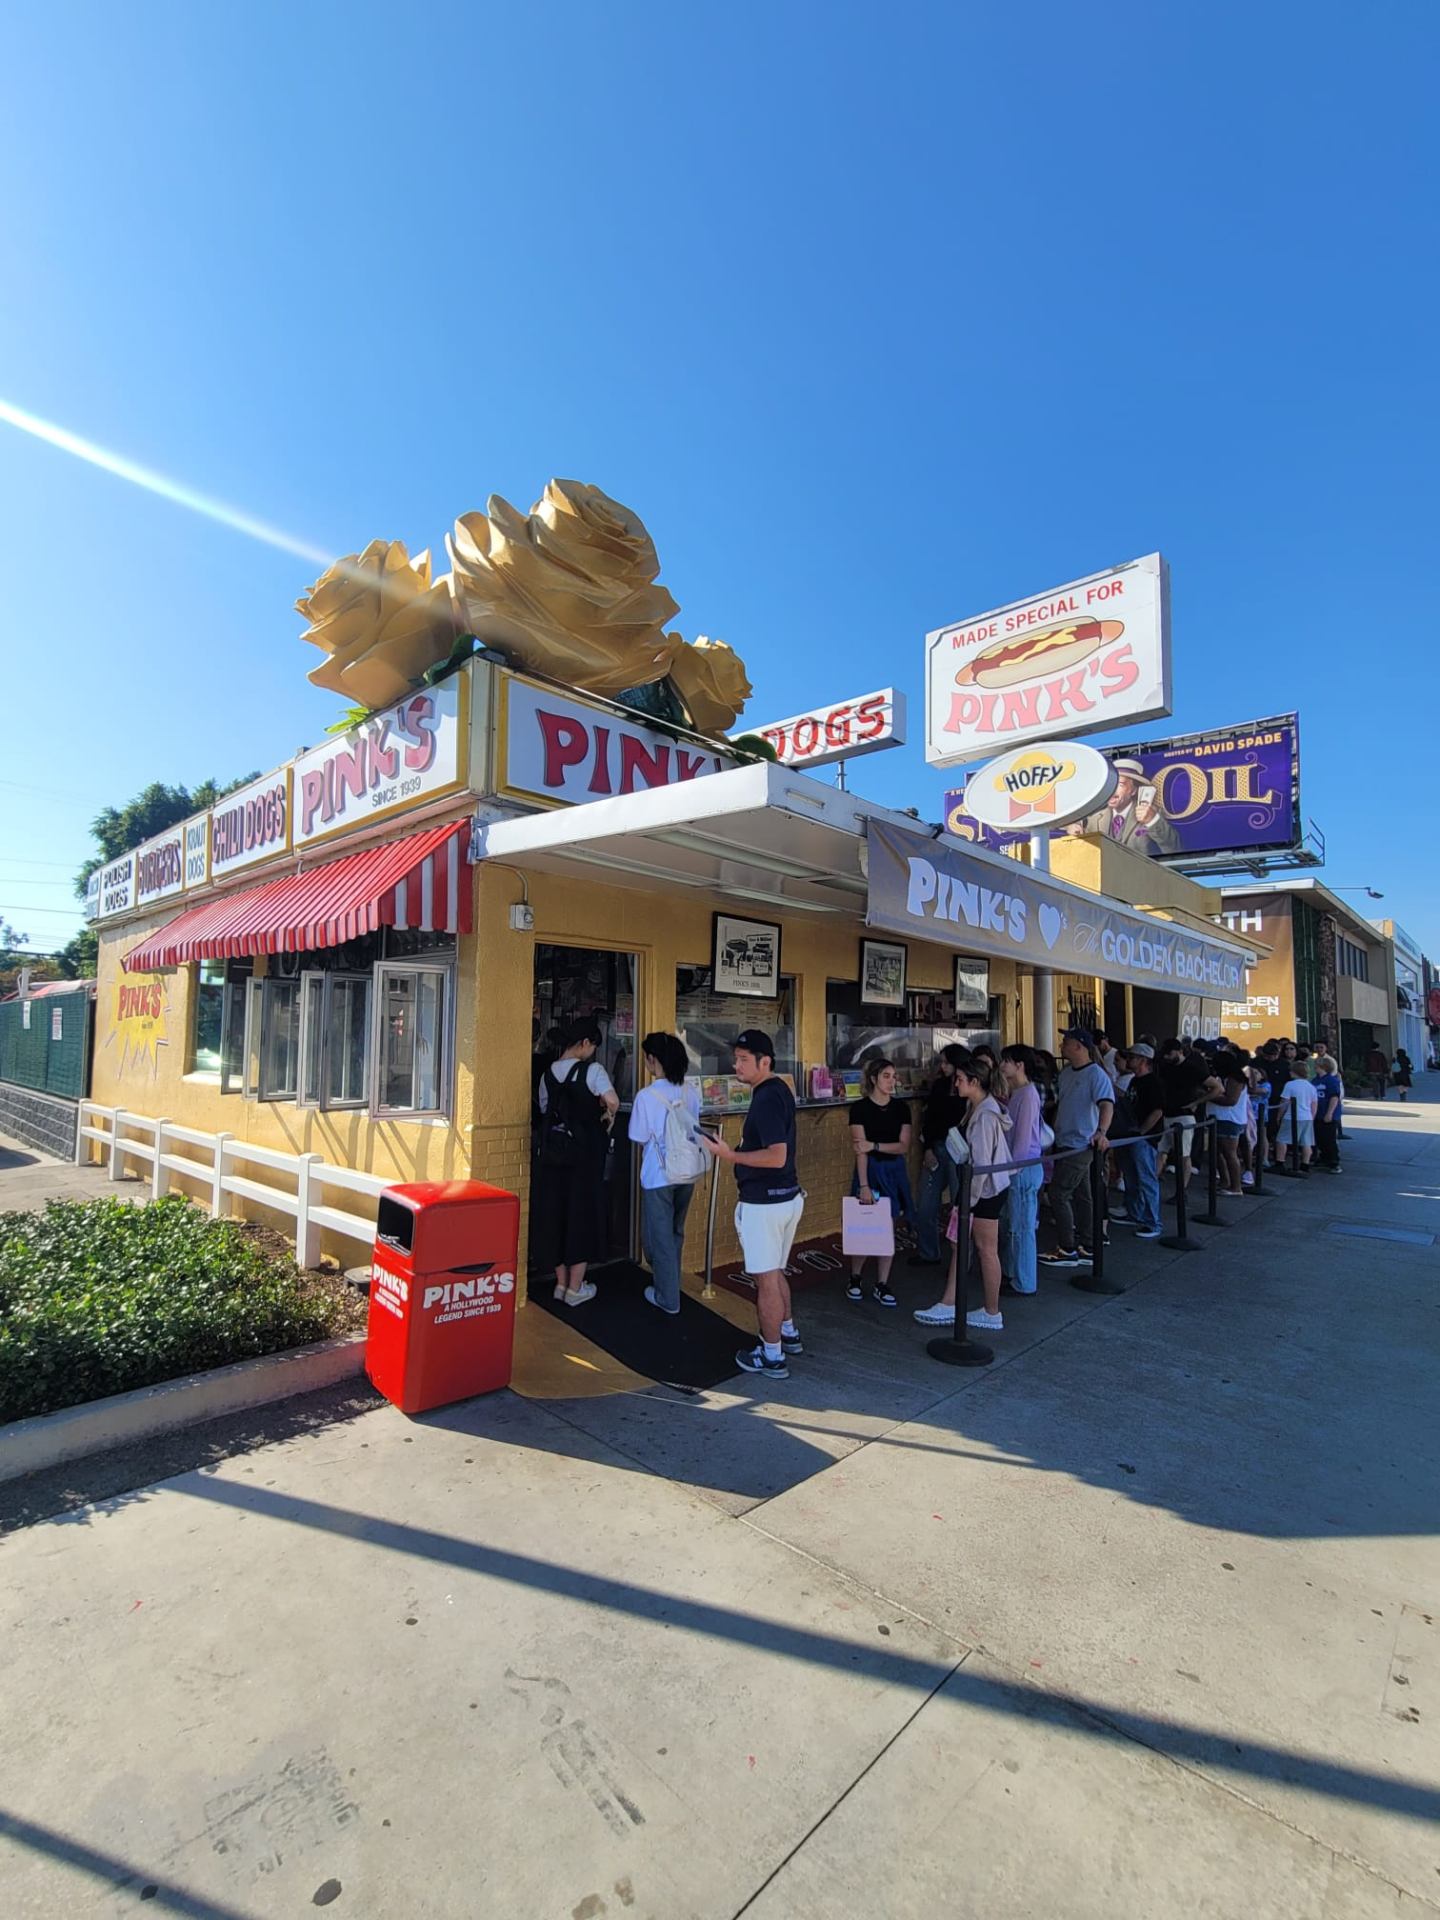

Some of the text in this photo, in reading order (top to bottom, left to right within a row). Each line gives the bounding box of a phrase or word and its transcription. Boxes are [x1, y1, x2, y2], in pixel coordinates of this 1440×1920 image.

[952, 580, 1124, 649] MADE SPECIAL FOR
[943, 643, 1140, 734] PINK'S
[1194, 741, 1235, 757] DAVID
[1237, 732, 1282, 749] SPADE
[301, 695, 437, 837] PINK'S
[1005, 765, 1064, 792] HOFFY
[372, 776, 422, 808] SINCE 1939
[1151, 762, 1272, 820] OIL
[212, 784, 286, 863] CHILI DOGS
[104, 860, 132, 889] POLISH
[139, 839, 182, 895] BURGERS
[187, 853, 205, 880] DOGS
[105, 887, 129, 912] DOGS
[906, 857, 1027, 943] PINK'S
[1101, 928, 1172, 976] GOLDEN
[1175, 951, 1239, 988] BACHELOR
[117, 982, 161, 1021] PINK'S
[373, 1263, 408, 1302] PINK'S
[423, 1272, 514, 1309] PINK'S
[434, 1303, 501, 1324] LEGEND SINCE 1939
[444, 1296, 494, 1312] A HOLLYWOOD
